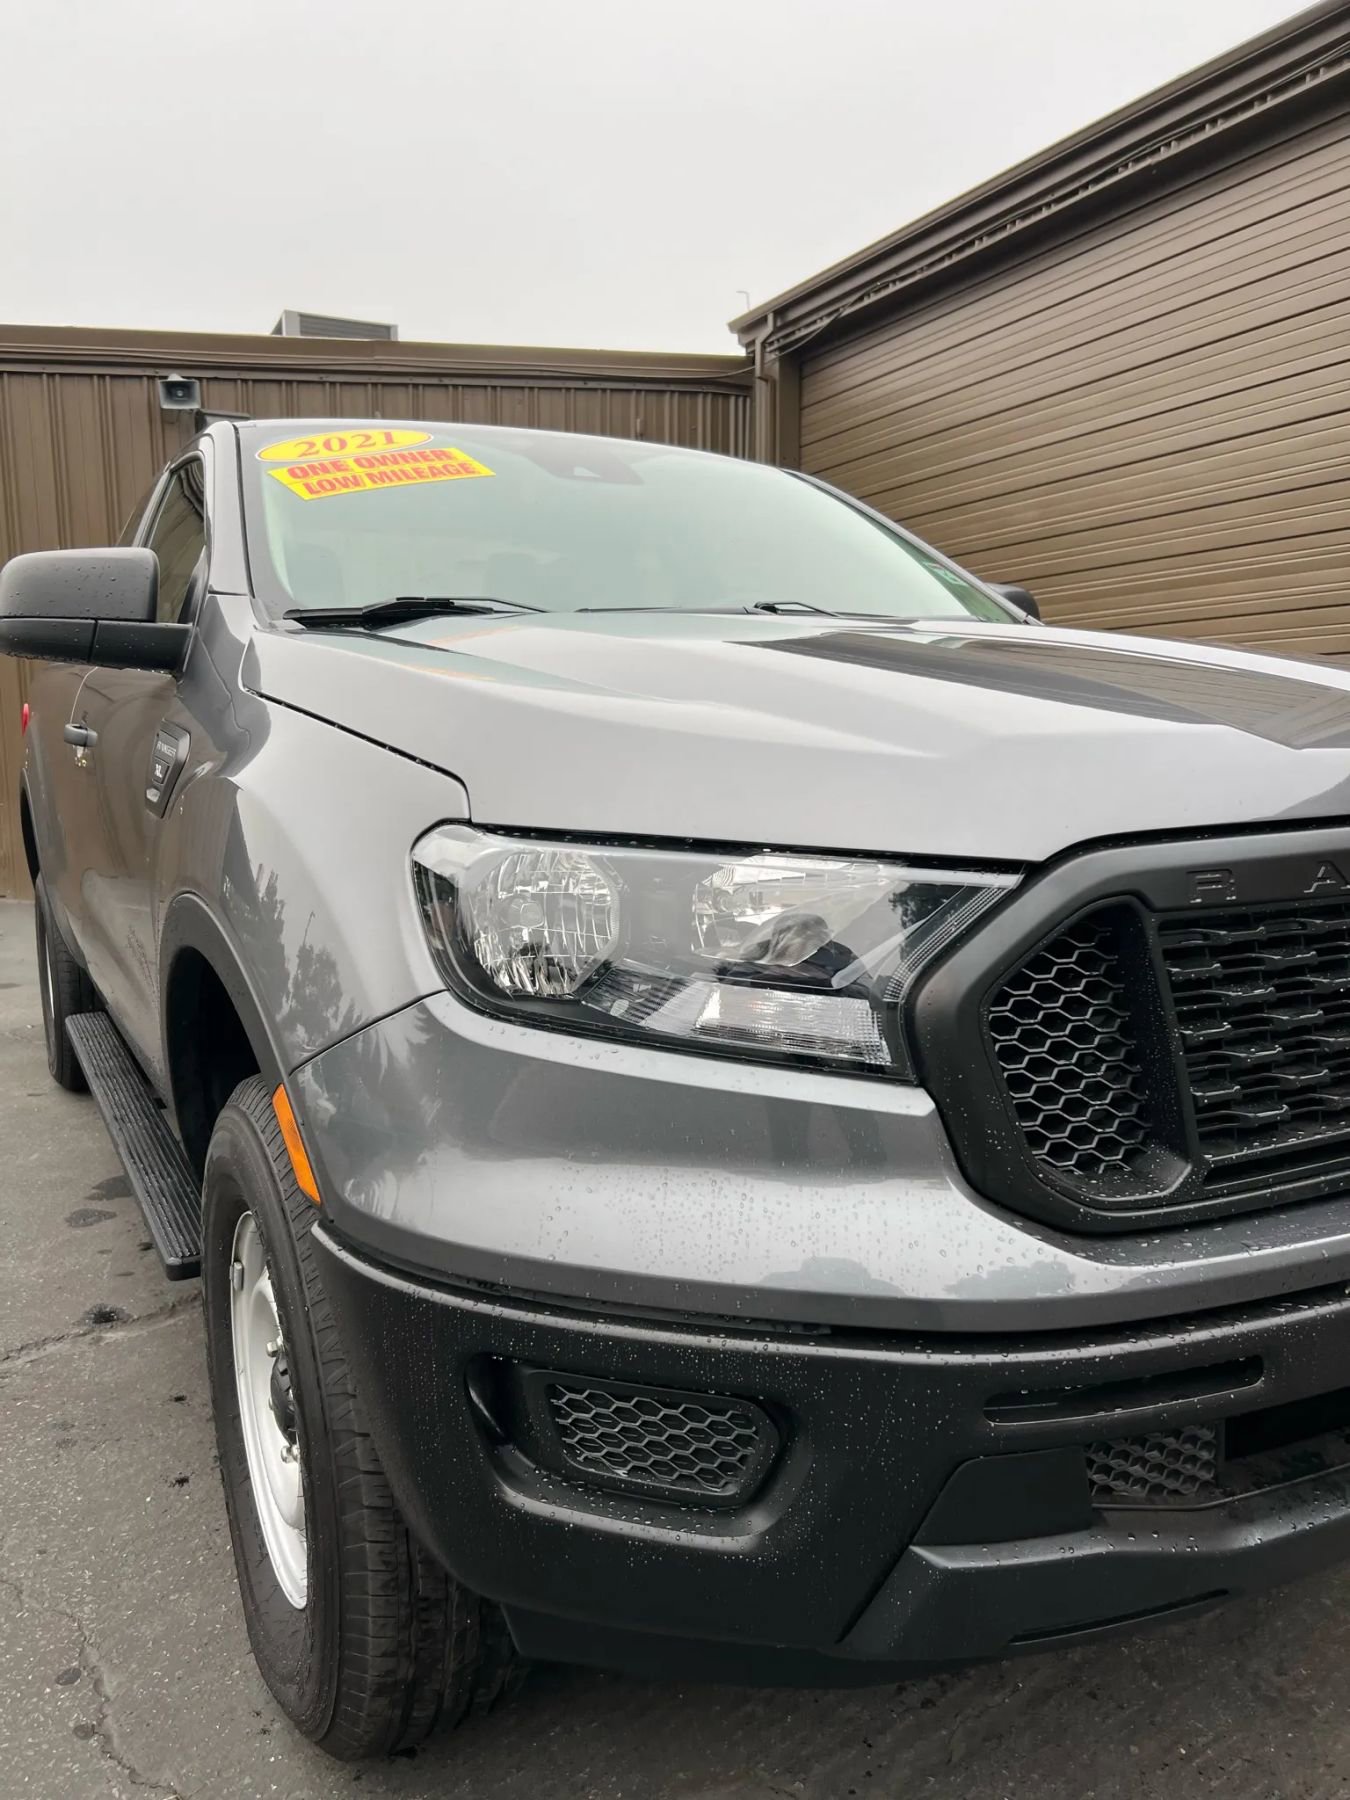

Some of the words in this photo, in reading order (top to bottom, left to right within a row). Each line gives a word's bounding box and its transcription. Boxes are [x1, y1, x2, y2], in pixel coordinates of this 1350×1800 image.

[294, 431, 400, 458] 2021
[286, 458, 350, 480] ONE
[353, 448, 455, 469] OWNER
[302, 474, 363, 495] LOW
[367, 461, 476, 485] MILEAGE
